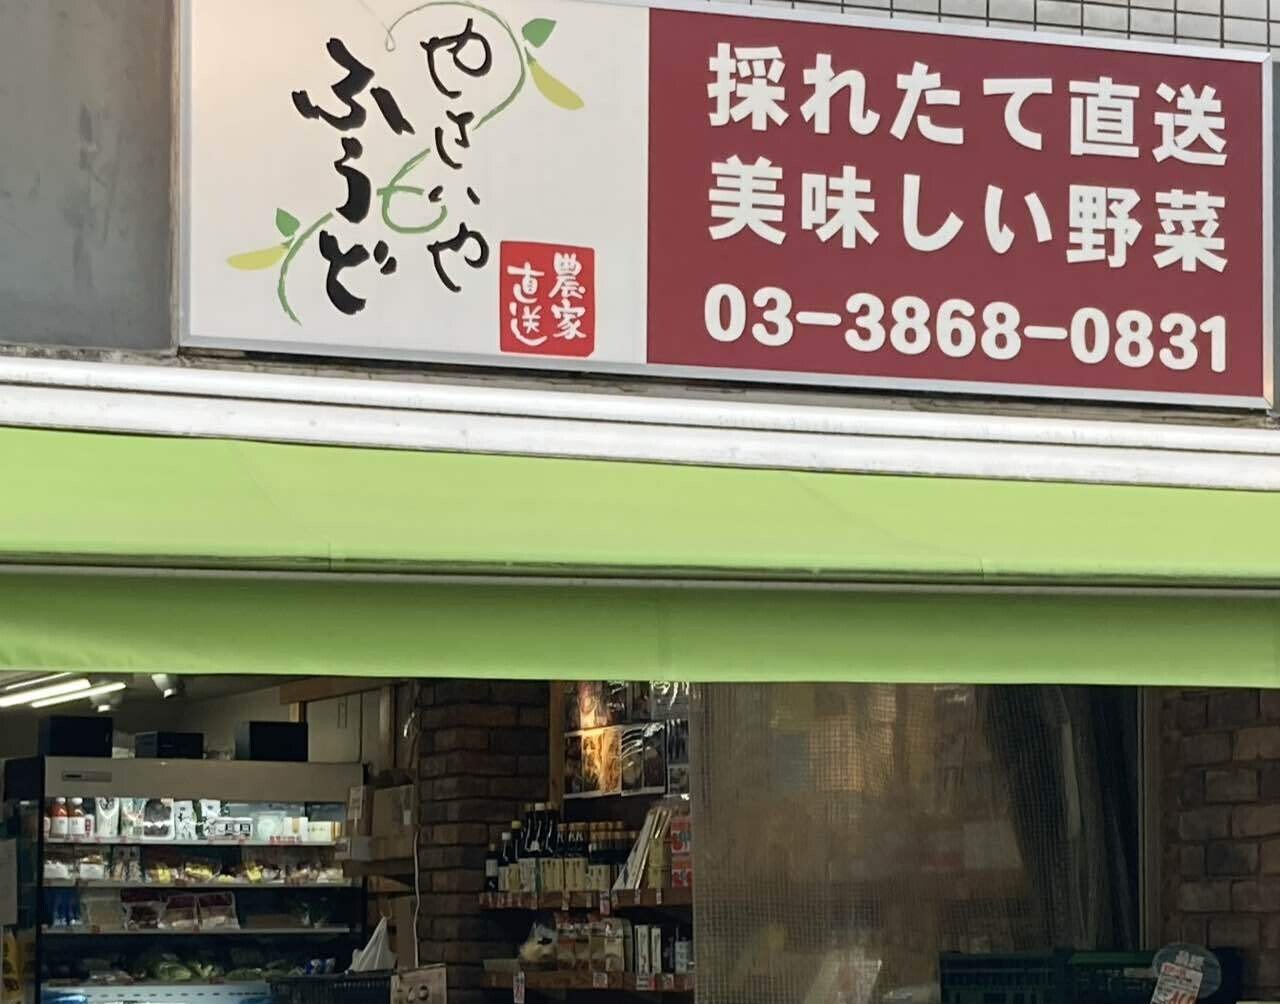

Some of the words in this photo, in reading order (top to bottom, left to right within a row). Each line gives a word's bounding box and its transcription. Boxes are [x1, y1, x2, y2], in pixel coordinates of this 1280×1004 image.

[419, 18, 493, 293] やさいや
[706, 42, 1228, 166] 採れたて直送
[291, 37, 416, 316] ふうど
[707, 154, 1228, 273] 美味しい野菜
[507, 262, 548, 347] 直送
[549, 252, 587, 340] 農家
[704, 283, 1227, 374] 03-3868-0831
